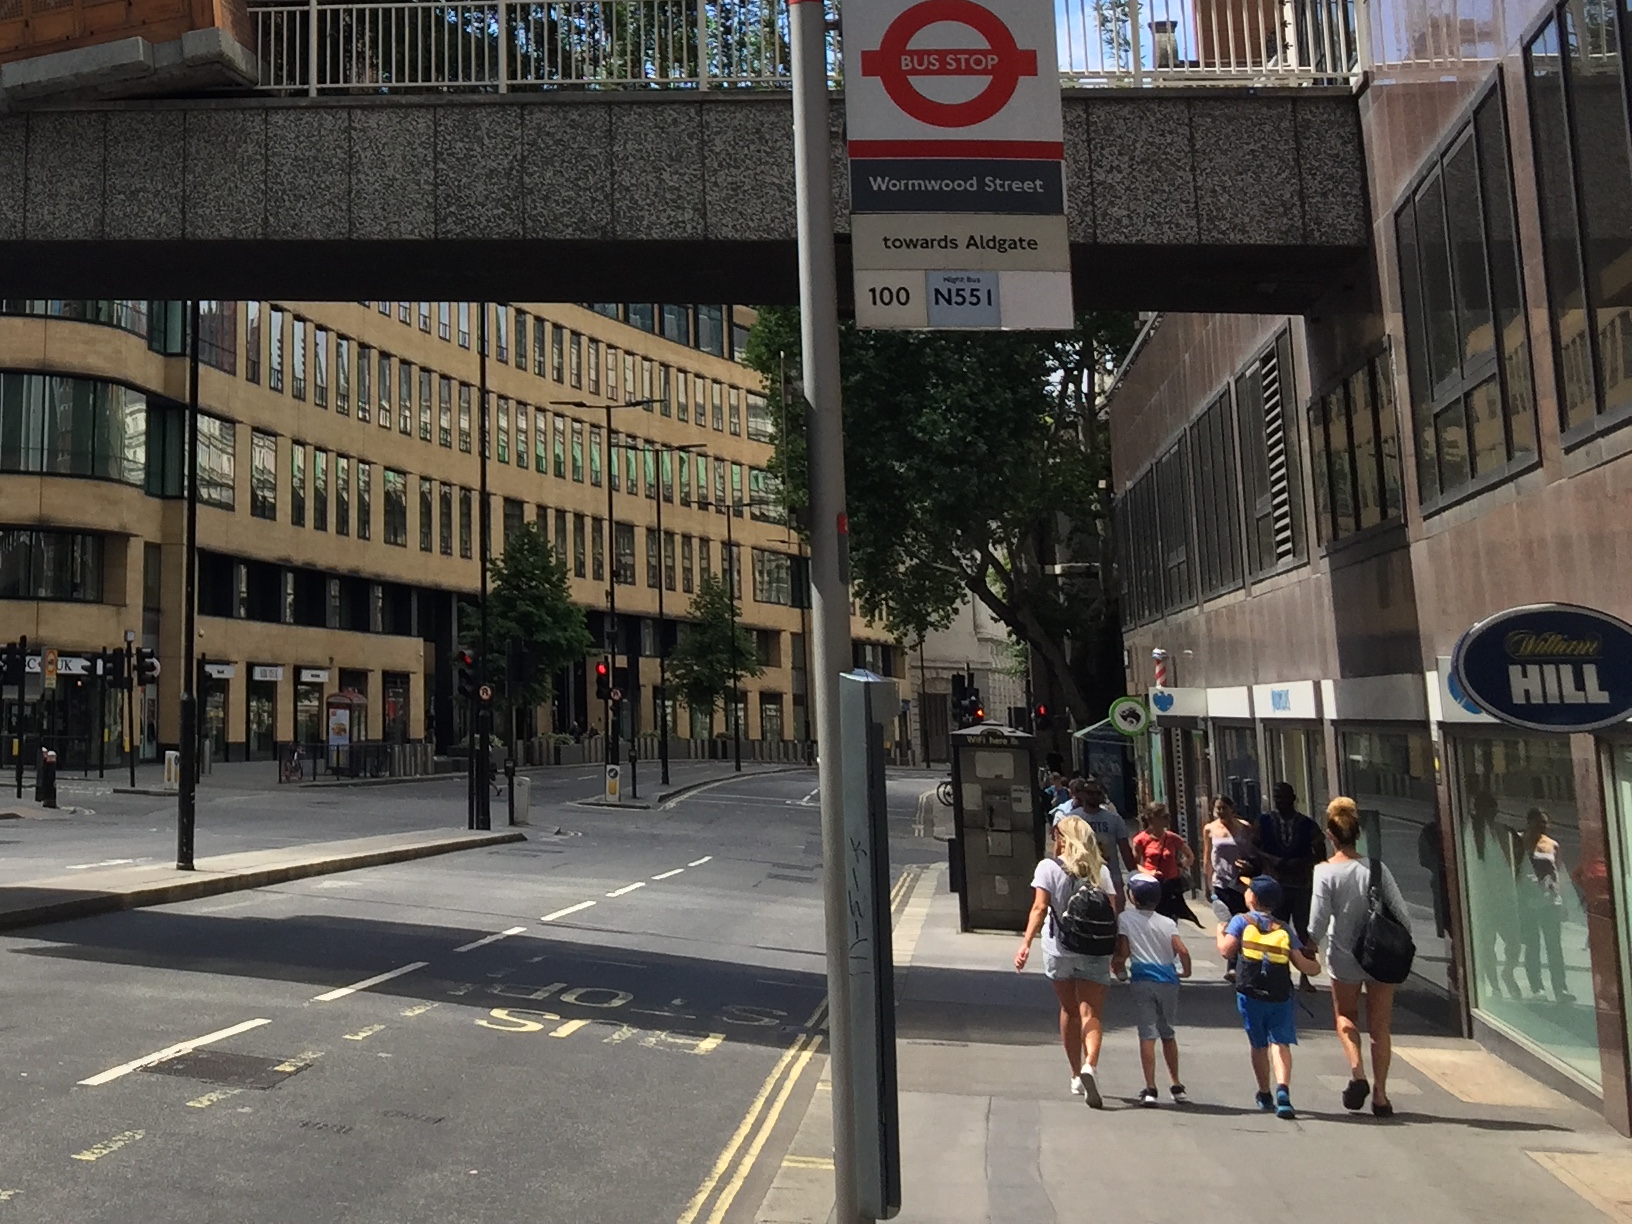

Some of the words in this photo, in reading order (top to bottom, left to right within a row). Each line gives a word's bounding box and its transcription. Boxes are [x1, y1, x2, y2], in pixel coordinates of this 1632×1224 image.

[900, 54, 940, 71] BUS
[945, 54, 999, 70] STOP
[868, 176, 978, 192] Wormwood
[984, 176, 1045, 193] Street
[882, 234, 959, 250] towards
[965, 234, 1039, 254] Aldgate
[942, 275, 965, 285] Night
[966, 275, 981, 284] Bus
[868, 286, 910, 307] 100
[934, 287, 993, 307] N551
[1505, 629, 1602, 657] William
[1508, 663, 1611, 705] HILL
